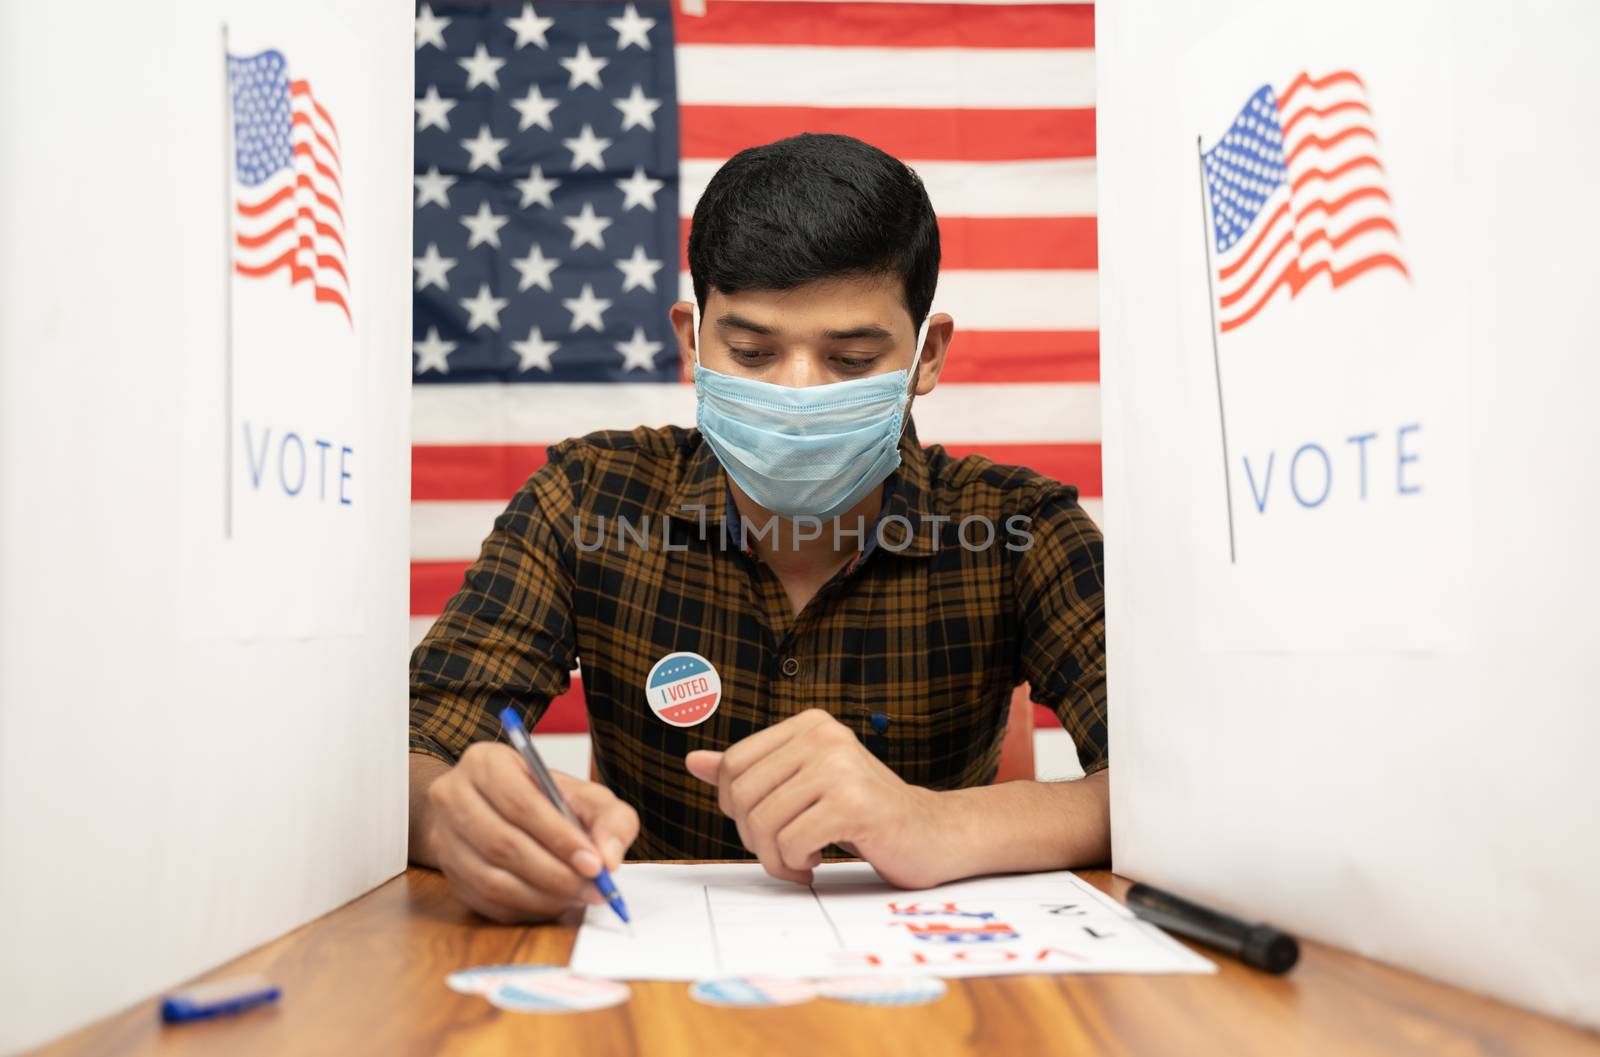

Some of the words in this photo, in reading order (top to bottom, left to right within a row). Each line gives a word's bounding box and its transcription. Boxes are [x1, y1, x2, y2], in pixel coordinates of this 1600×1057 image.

[243, 420, 354, 505] VOTE
[1243, 423, 1422, 514] VOTE
[661, 688, 667, 704] I
[668, 677, 709, 701] VOTED
